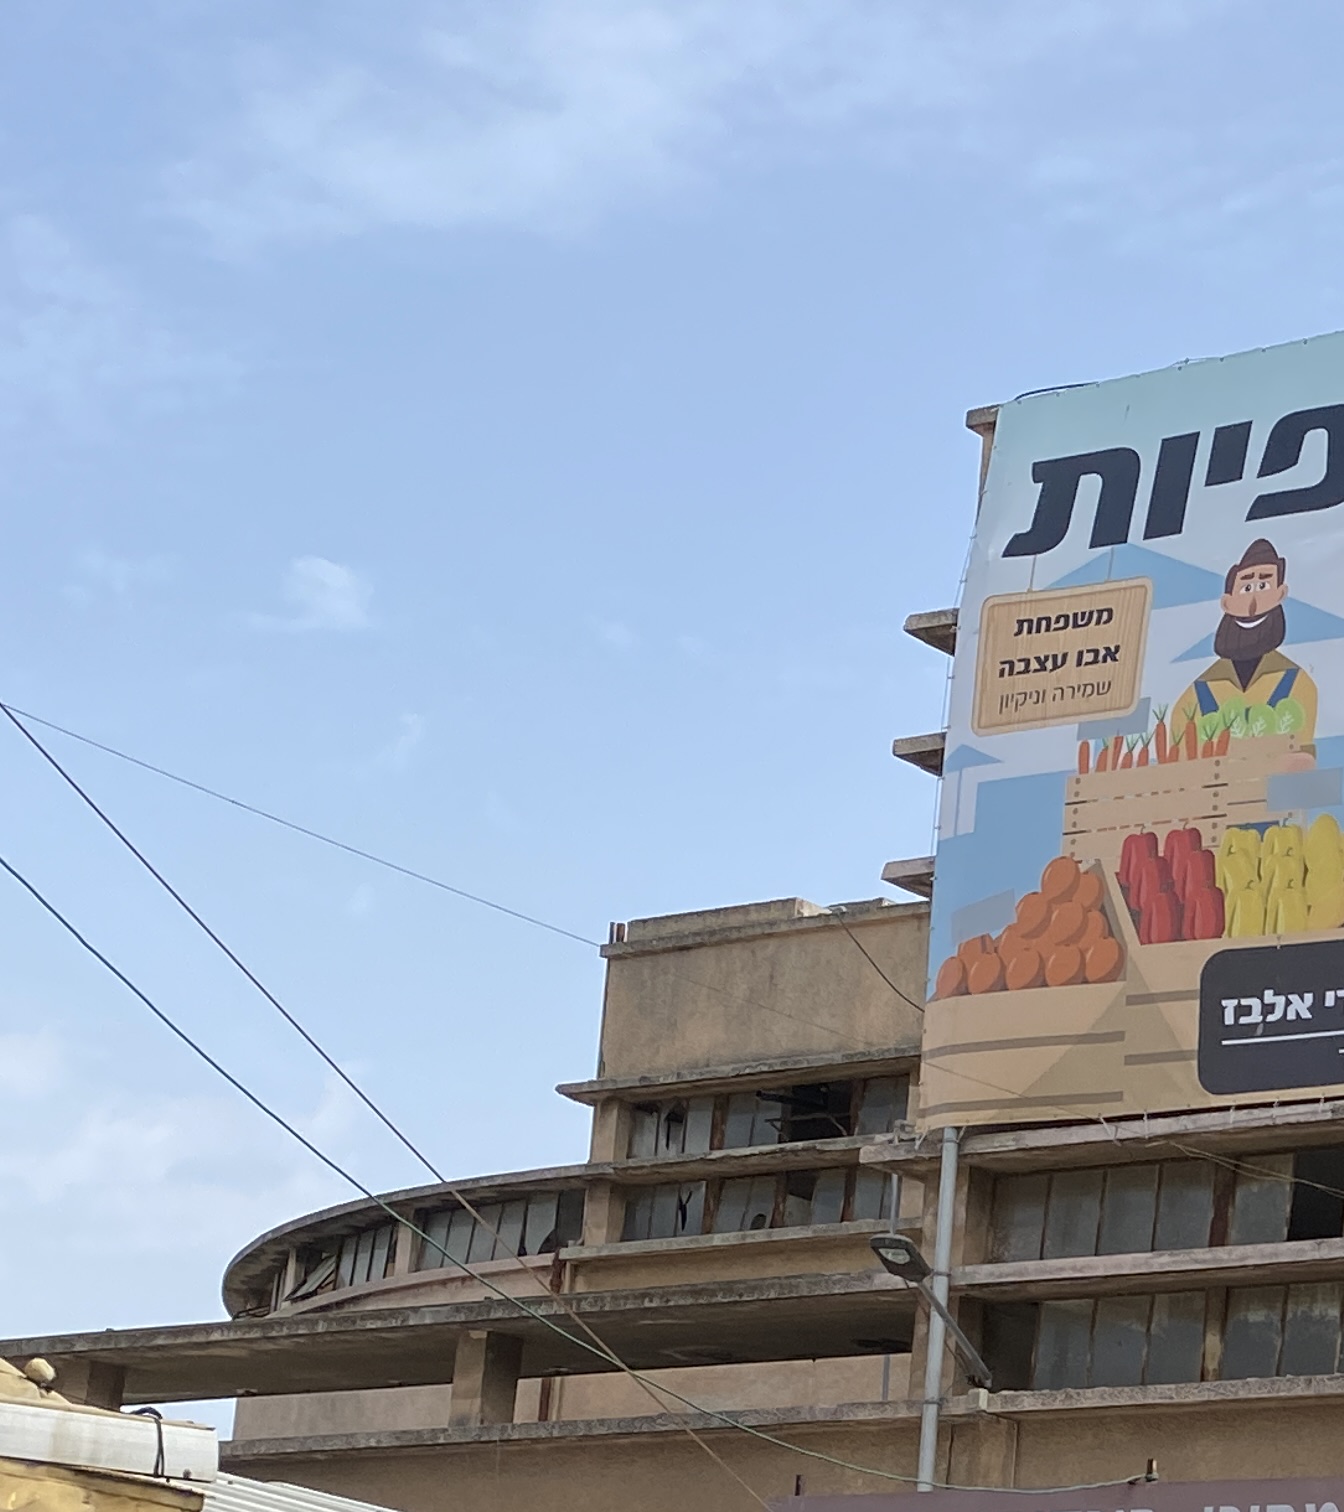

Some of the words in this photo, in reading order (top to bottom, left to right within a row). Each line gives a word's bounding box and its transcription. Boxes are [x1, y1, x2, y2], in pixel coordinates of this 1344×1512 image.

[1013, 607, 1113, 637] משפחת
[998, 651, 1069, 679] עצבה
[1075, 644, 1120, 668] אבו
[999, 688, 1046, 715] וניקיון
[1052, 680, 1112, 702] שמירה
[1221, 988, 1313, 1026] אלבז
